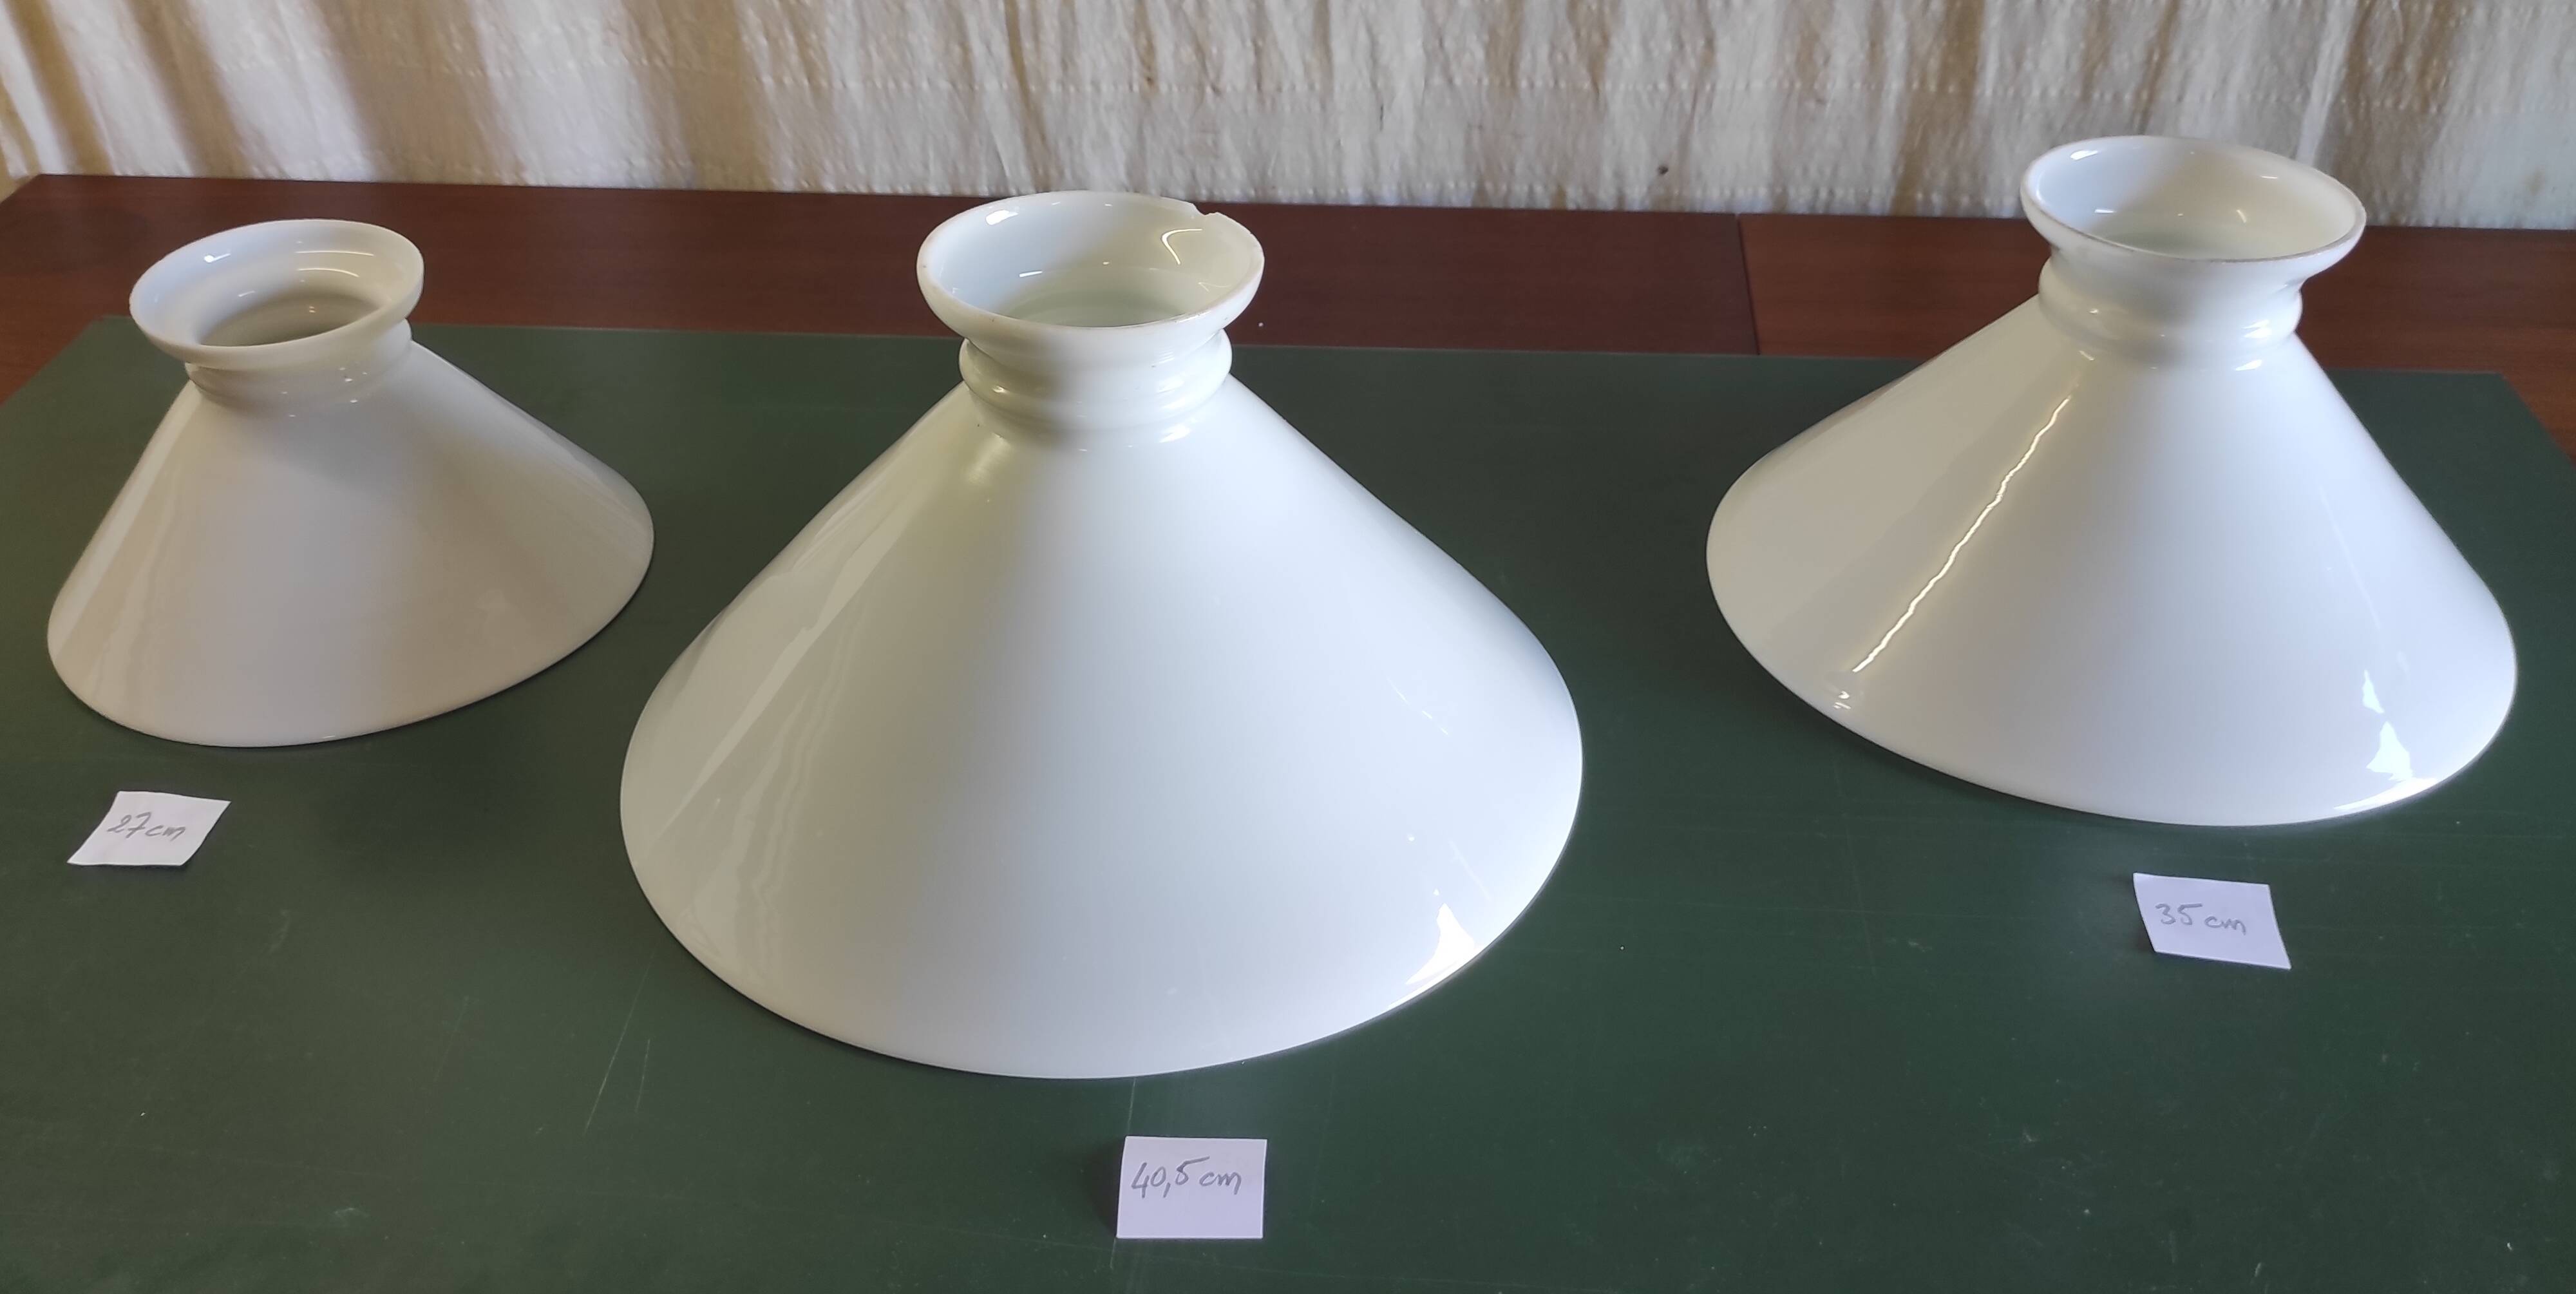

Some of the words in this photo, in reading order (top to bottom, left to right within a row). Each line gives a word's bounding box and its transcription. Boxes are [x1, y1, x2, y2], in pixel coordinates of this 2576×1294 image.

[2155, 902, 2203, 926] 35
[2204, 915, 2246, 935] cm
[1131, 1156, 1210, 1199] 40,5
[1198, 1171, 1242, 1195] cm
